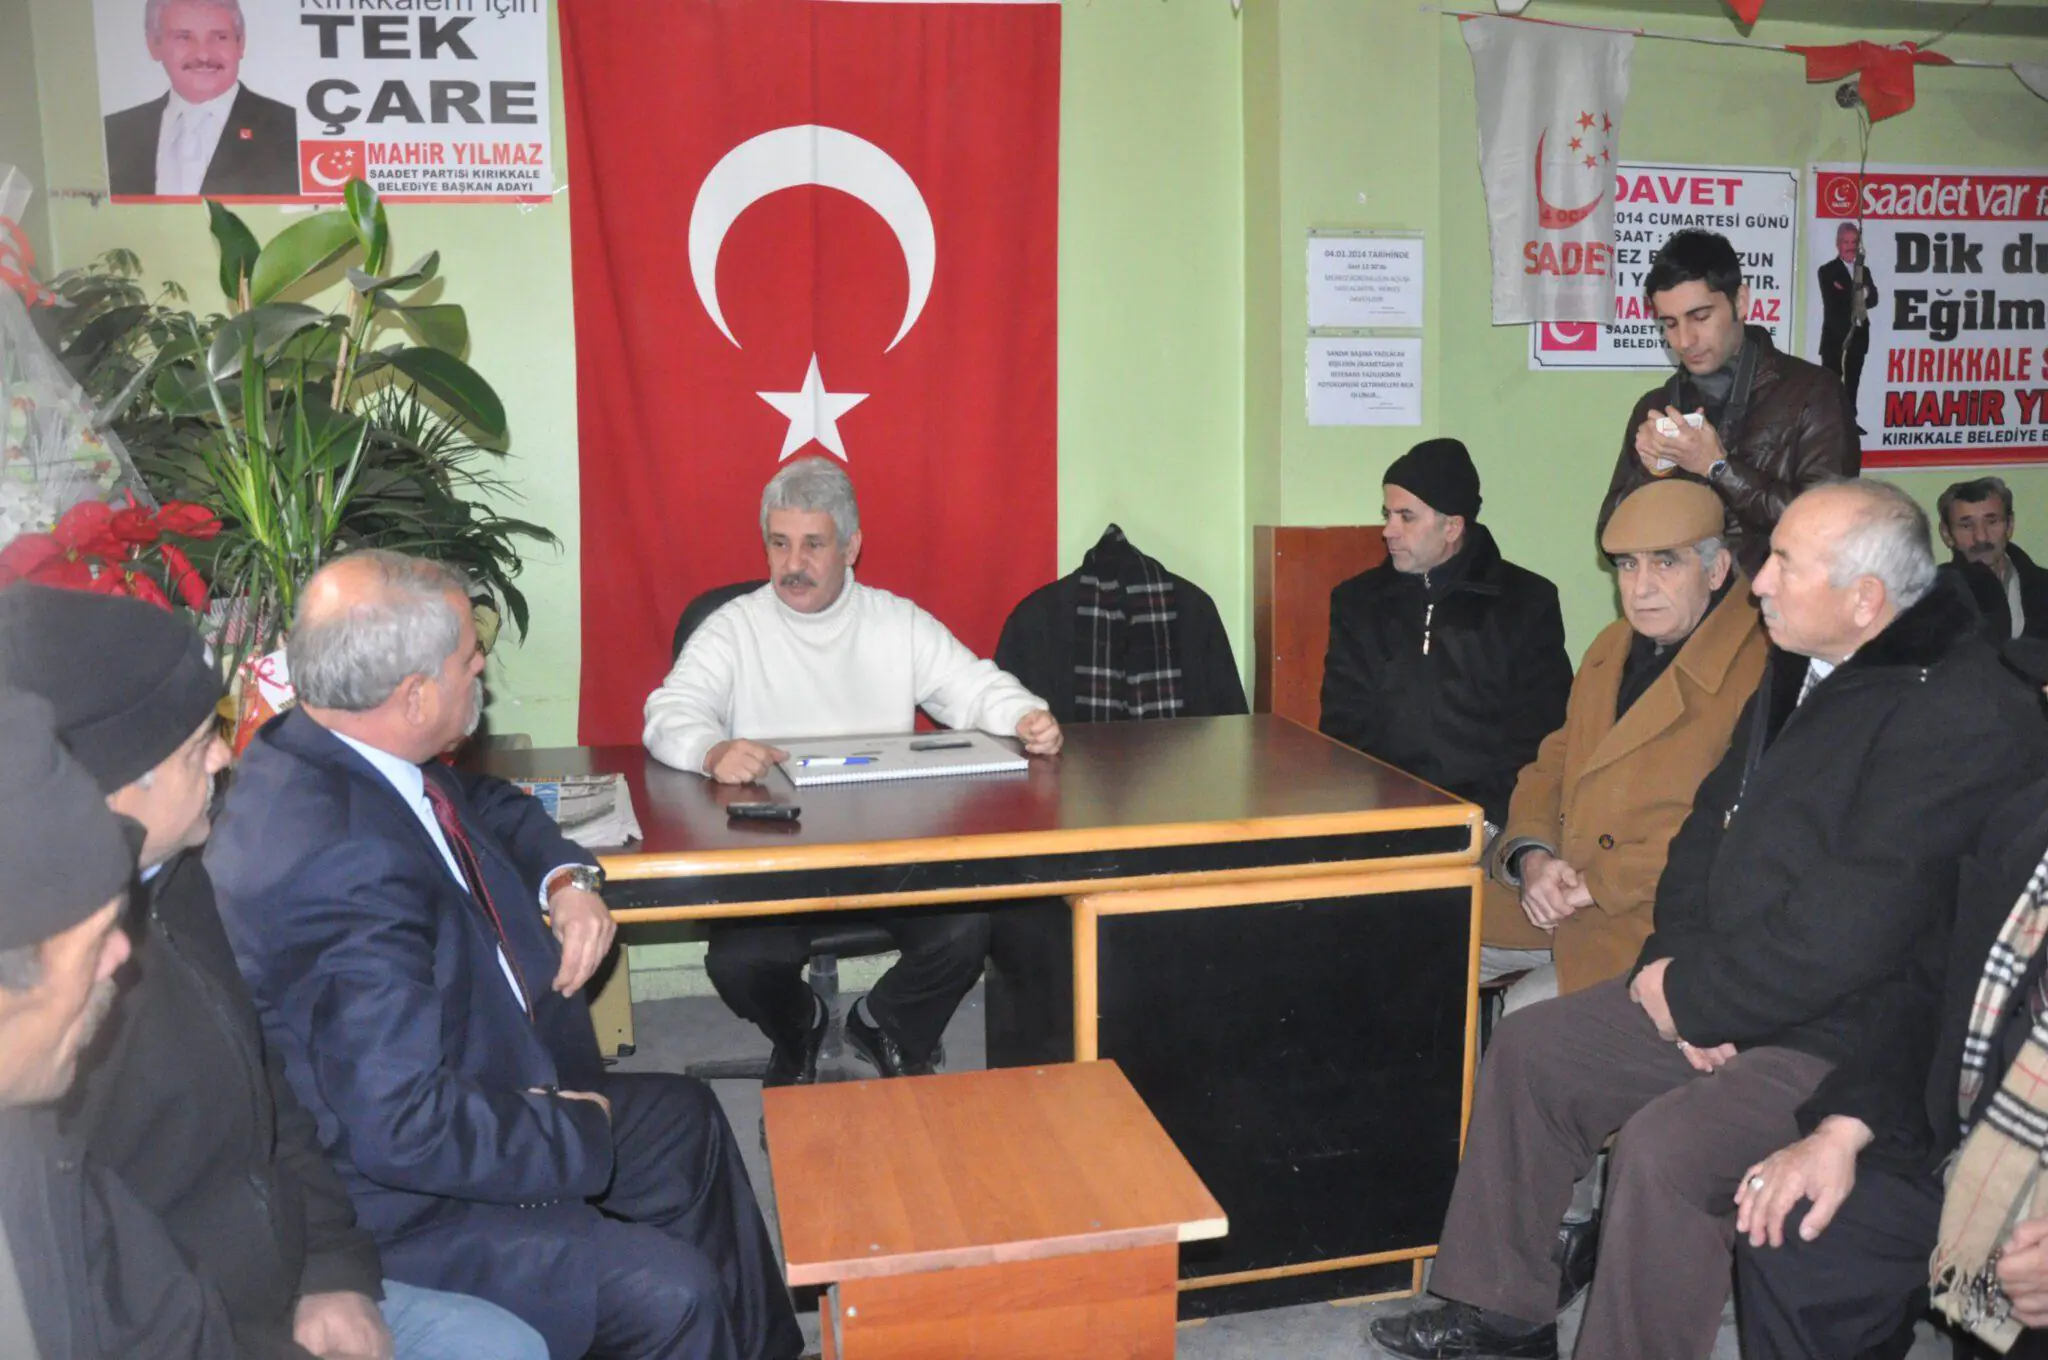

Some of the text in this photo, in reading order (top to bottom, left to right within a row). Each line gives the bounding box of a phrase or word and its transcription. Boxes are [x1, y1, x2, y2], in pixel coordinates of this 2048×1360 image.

[301, 14, 478, 60] TEK
[306, 79, 538, 135] ÇARE
[451, 142, 543, 165] YILMAZ
[369, 169, 418, 179] SAADET
[472, 169, 541, 179] KIRIKKALE
[441, 182, 493, 193] BAŞKAN
[496, 182, 533, 192] ADAYI
[1615, 174, 1743, 206] DAVET
[1862, 177, 1972, 216] saadet
[1976, 183, 2031, 216] var
[1613, 211, 1643, 225] 014
[1648, 212, 1740, 228] CUMARTESİ
[1745, 213, 1790, 229] GÜNÜ
[1615, 230, 1653, 243] SAAT
[1894, 232, 1984, 274] Dik
[1892, 288, 2046, 342] Eğilm
[1605, 325, 1656, 335] SAADET
[1887, 347, 2033, 382] KIRIKKALE
[1882, 430, 1963, 445] KIRIKKALE
[1967, 427, 2038, 443] BELEDİYE
